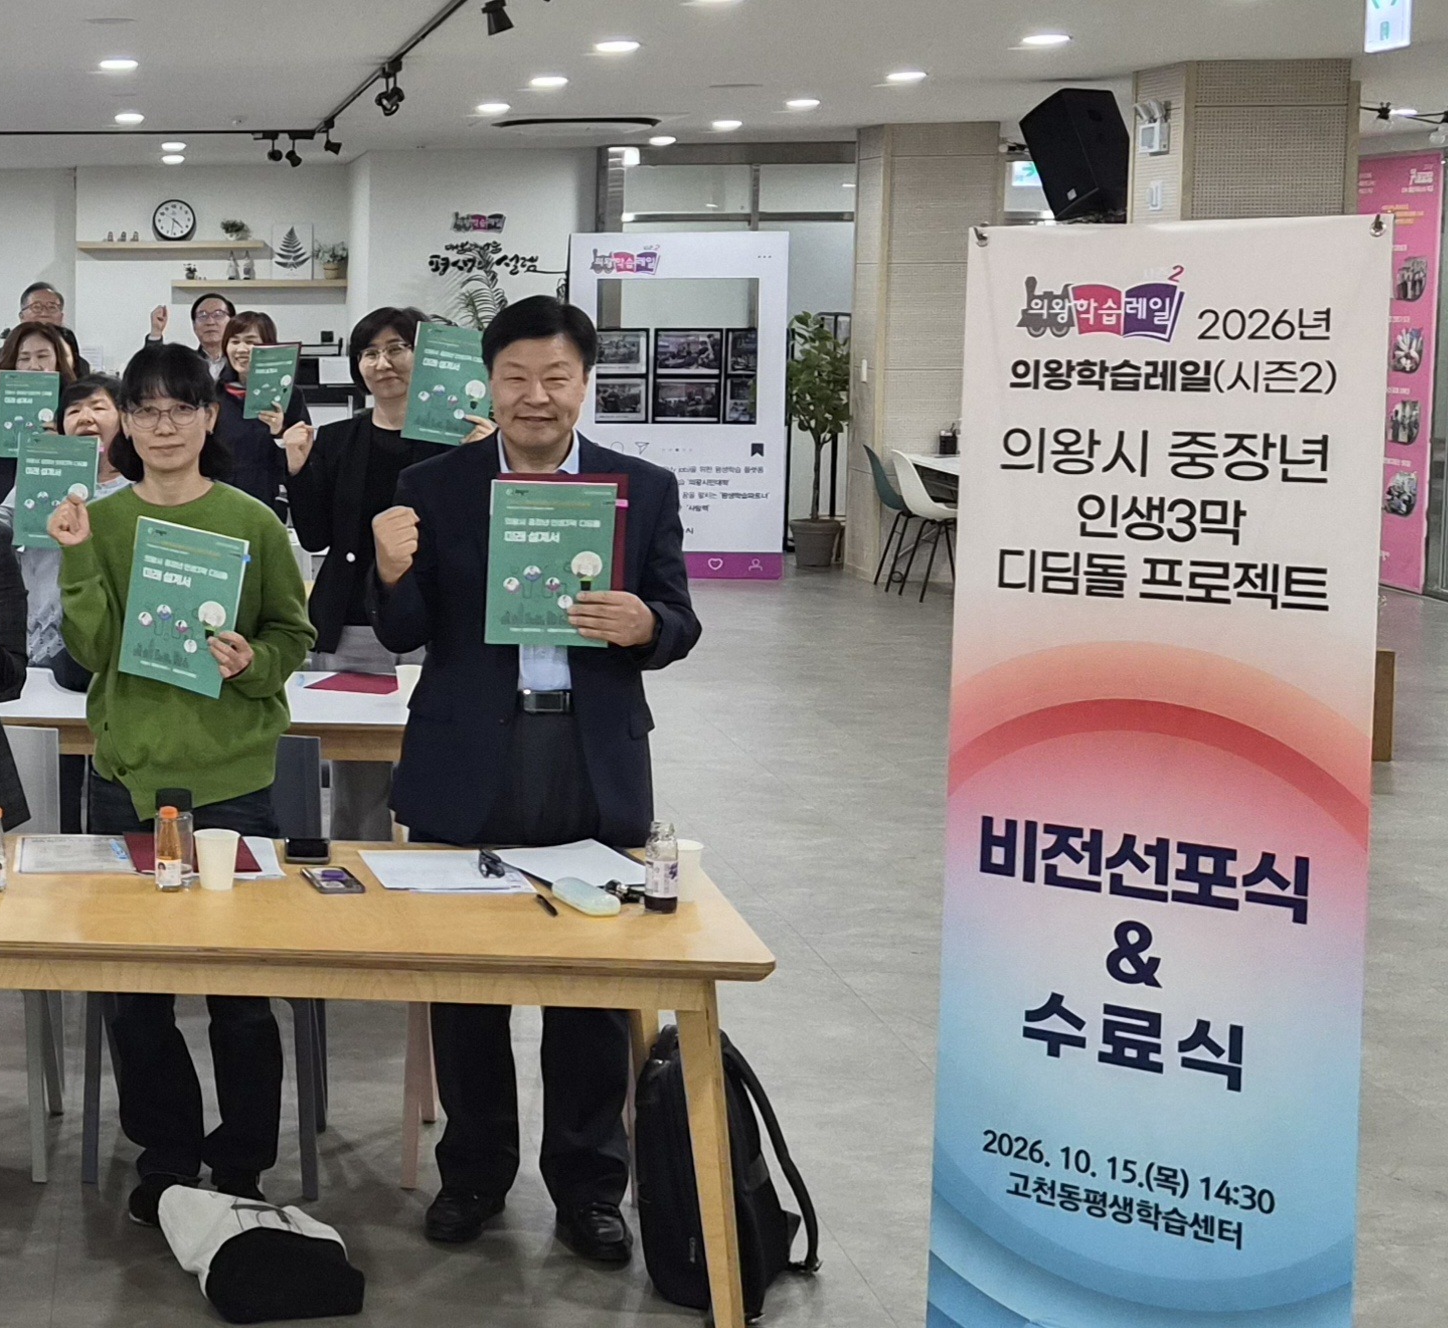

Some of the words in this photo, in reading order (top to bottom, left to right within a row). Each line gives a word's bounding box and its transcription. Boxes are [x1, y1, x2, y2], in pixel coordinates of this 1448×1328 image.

[1027, 296, 1172, 326] 의왕학습레일
[1197, 307, 1331, 341] 2026년
[1009, 359, 1337, 395] 의왕학습레일(시즌2)
[1000, 427, 1149, 478] 의왕시
[1168, 431, 1329, 484] 중장년
[1077, 494, 1247, 546] 인생3막
[998, 549, 1128, 599] 디딤돌
[1139, 557, 1329, 612] 프로젝트
[979, 815, 1310, 925] 비전선포식
[1106, 920, 1162, 989] &
[1022, 992, 1244, 1093] 수료식
[982, 1129, 1051, 1168] 2026.
[1060, 1146, 1097, 1178] 10.
[1107, 1156, 1189, 1199] 15.(목)
[1200, 1176, 1275, 1214] 14:30
[1006, 1171, 1243, 1250] 고천동평생학습센터
